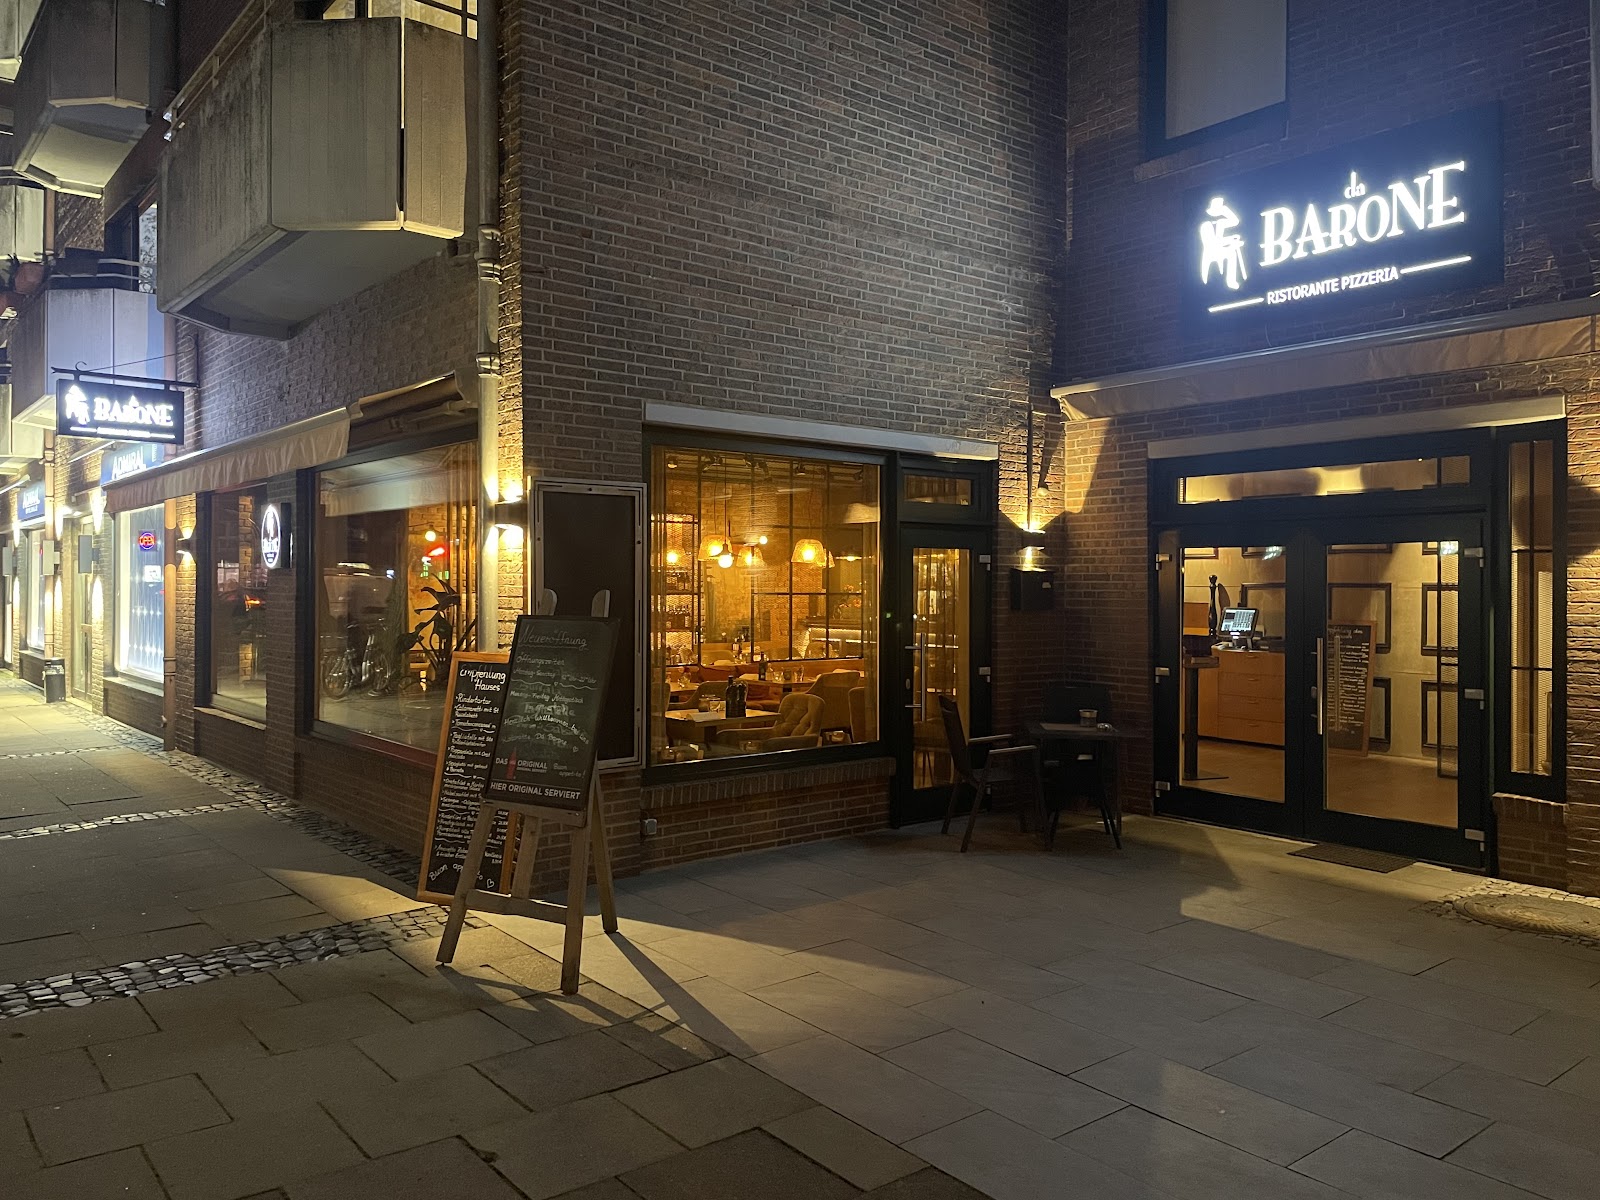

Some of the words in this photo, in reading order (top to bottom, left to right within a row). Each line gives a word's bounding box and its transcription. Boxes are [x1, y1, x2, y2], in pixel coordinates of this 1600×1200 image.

[1344, 170, 1366, 199] da
[1259, 160, 1466, 268] BARONE
[1267, 277, 1340, 305] RISTORANTE
[1341, 266, 1399, 291] PIZZERIA
[94, 397, 174, 427] BARONE
[474, 679, 501, 692] Hauses
[495, 757, 508, 765] DAS
[517, 759, 548, 769] ORIGINAL
[490, 782, 508, 792] HIER
[508, 783, 543, 796] ORIGINAL
[544, 788, 581, 800] SERVIERT
[428, 864, 449, 881] Buon
